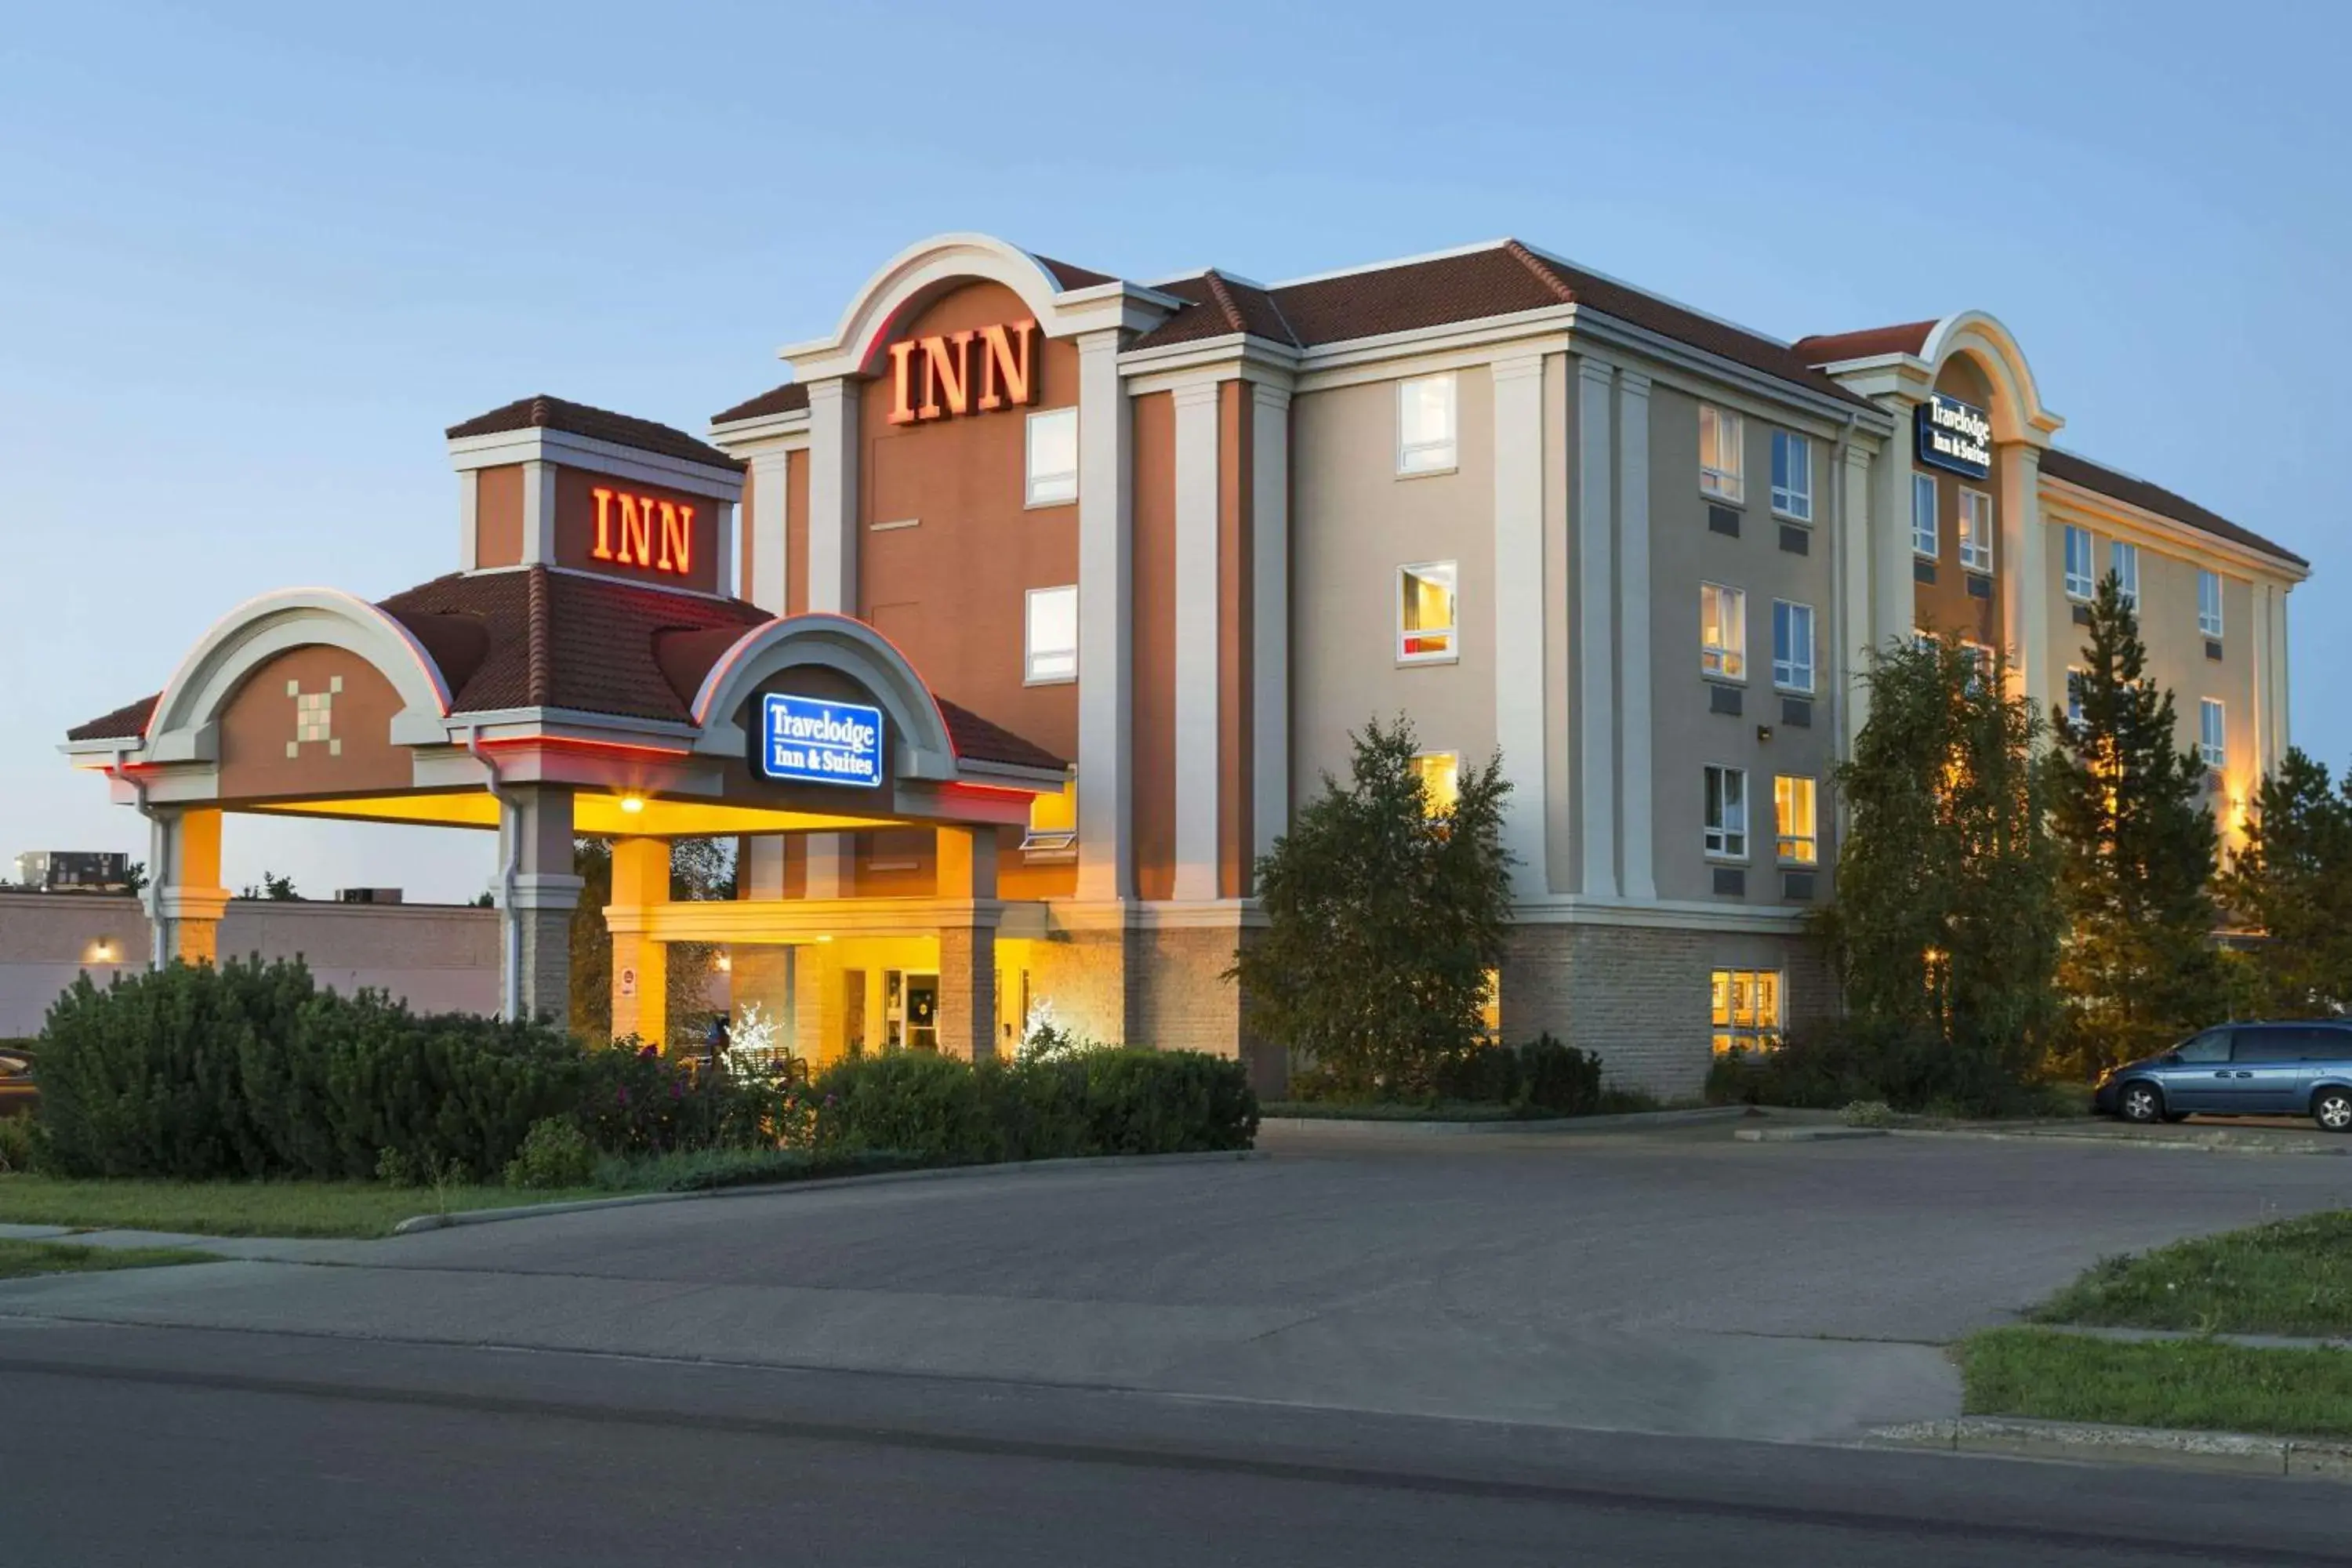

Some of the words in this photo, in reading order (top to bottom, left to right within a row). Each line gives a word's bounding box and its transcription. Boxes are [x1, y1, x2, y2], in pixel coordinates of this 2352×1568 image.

[887, 318, 1036, 425] INN
[593, 488, 695, 574] INN
[770, 704, 874, 752] Travelodge
[775, 745, 804, 767] Inn
[808, 749, 820, 770] &
[822, 751, 873, 775] Suites
